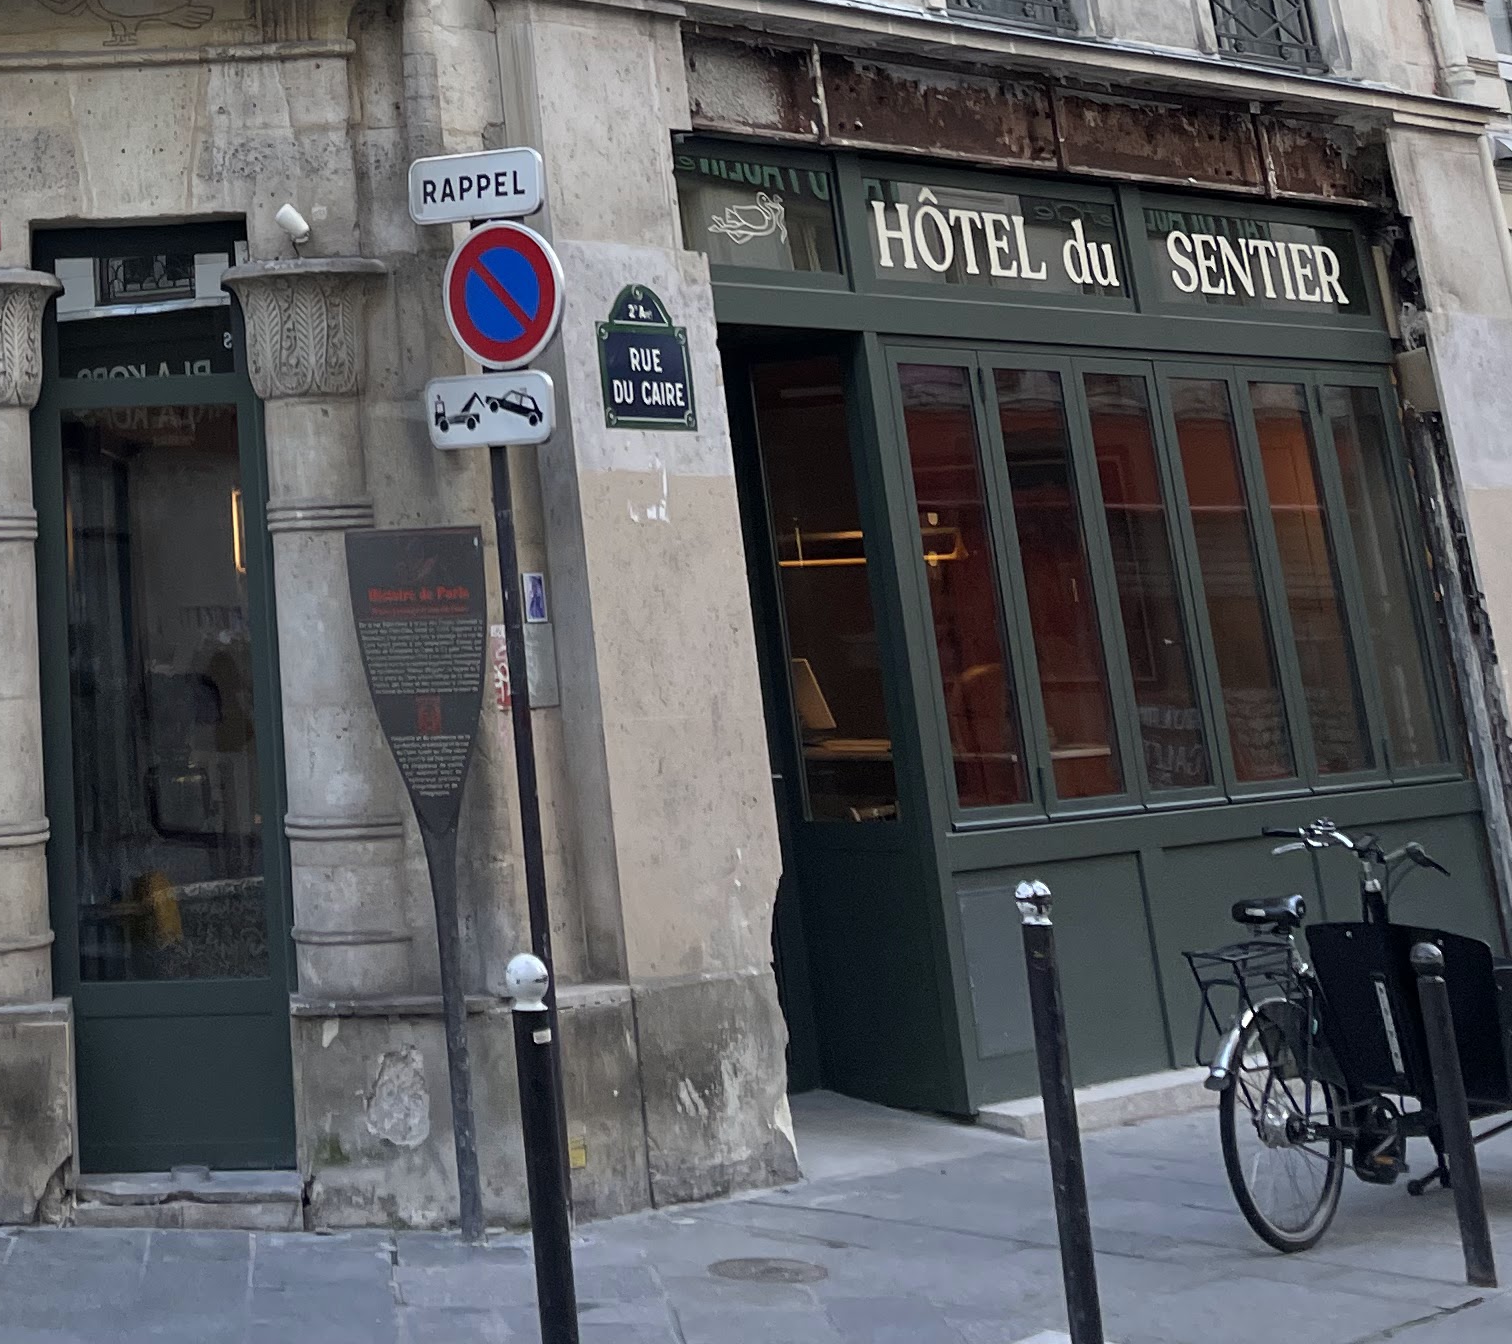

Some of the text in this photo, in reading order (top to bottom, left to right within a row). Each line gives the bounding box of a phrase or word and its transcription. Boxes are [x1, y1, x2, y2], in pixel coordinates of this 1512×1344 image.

[423, 170, 526, 205] RAPPEL
[871, 187, 1047, 280] HÔTEL
[1063, 219, 1120, 286] du
[1167, 231, 1350, 305] SENTIER
[629, 347, 662, 373] RUE
[612, 379, 685, 407] DU CAIRE
[420, 587, 432, 600] de
[436, 585, 470, 599] Paris
